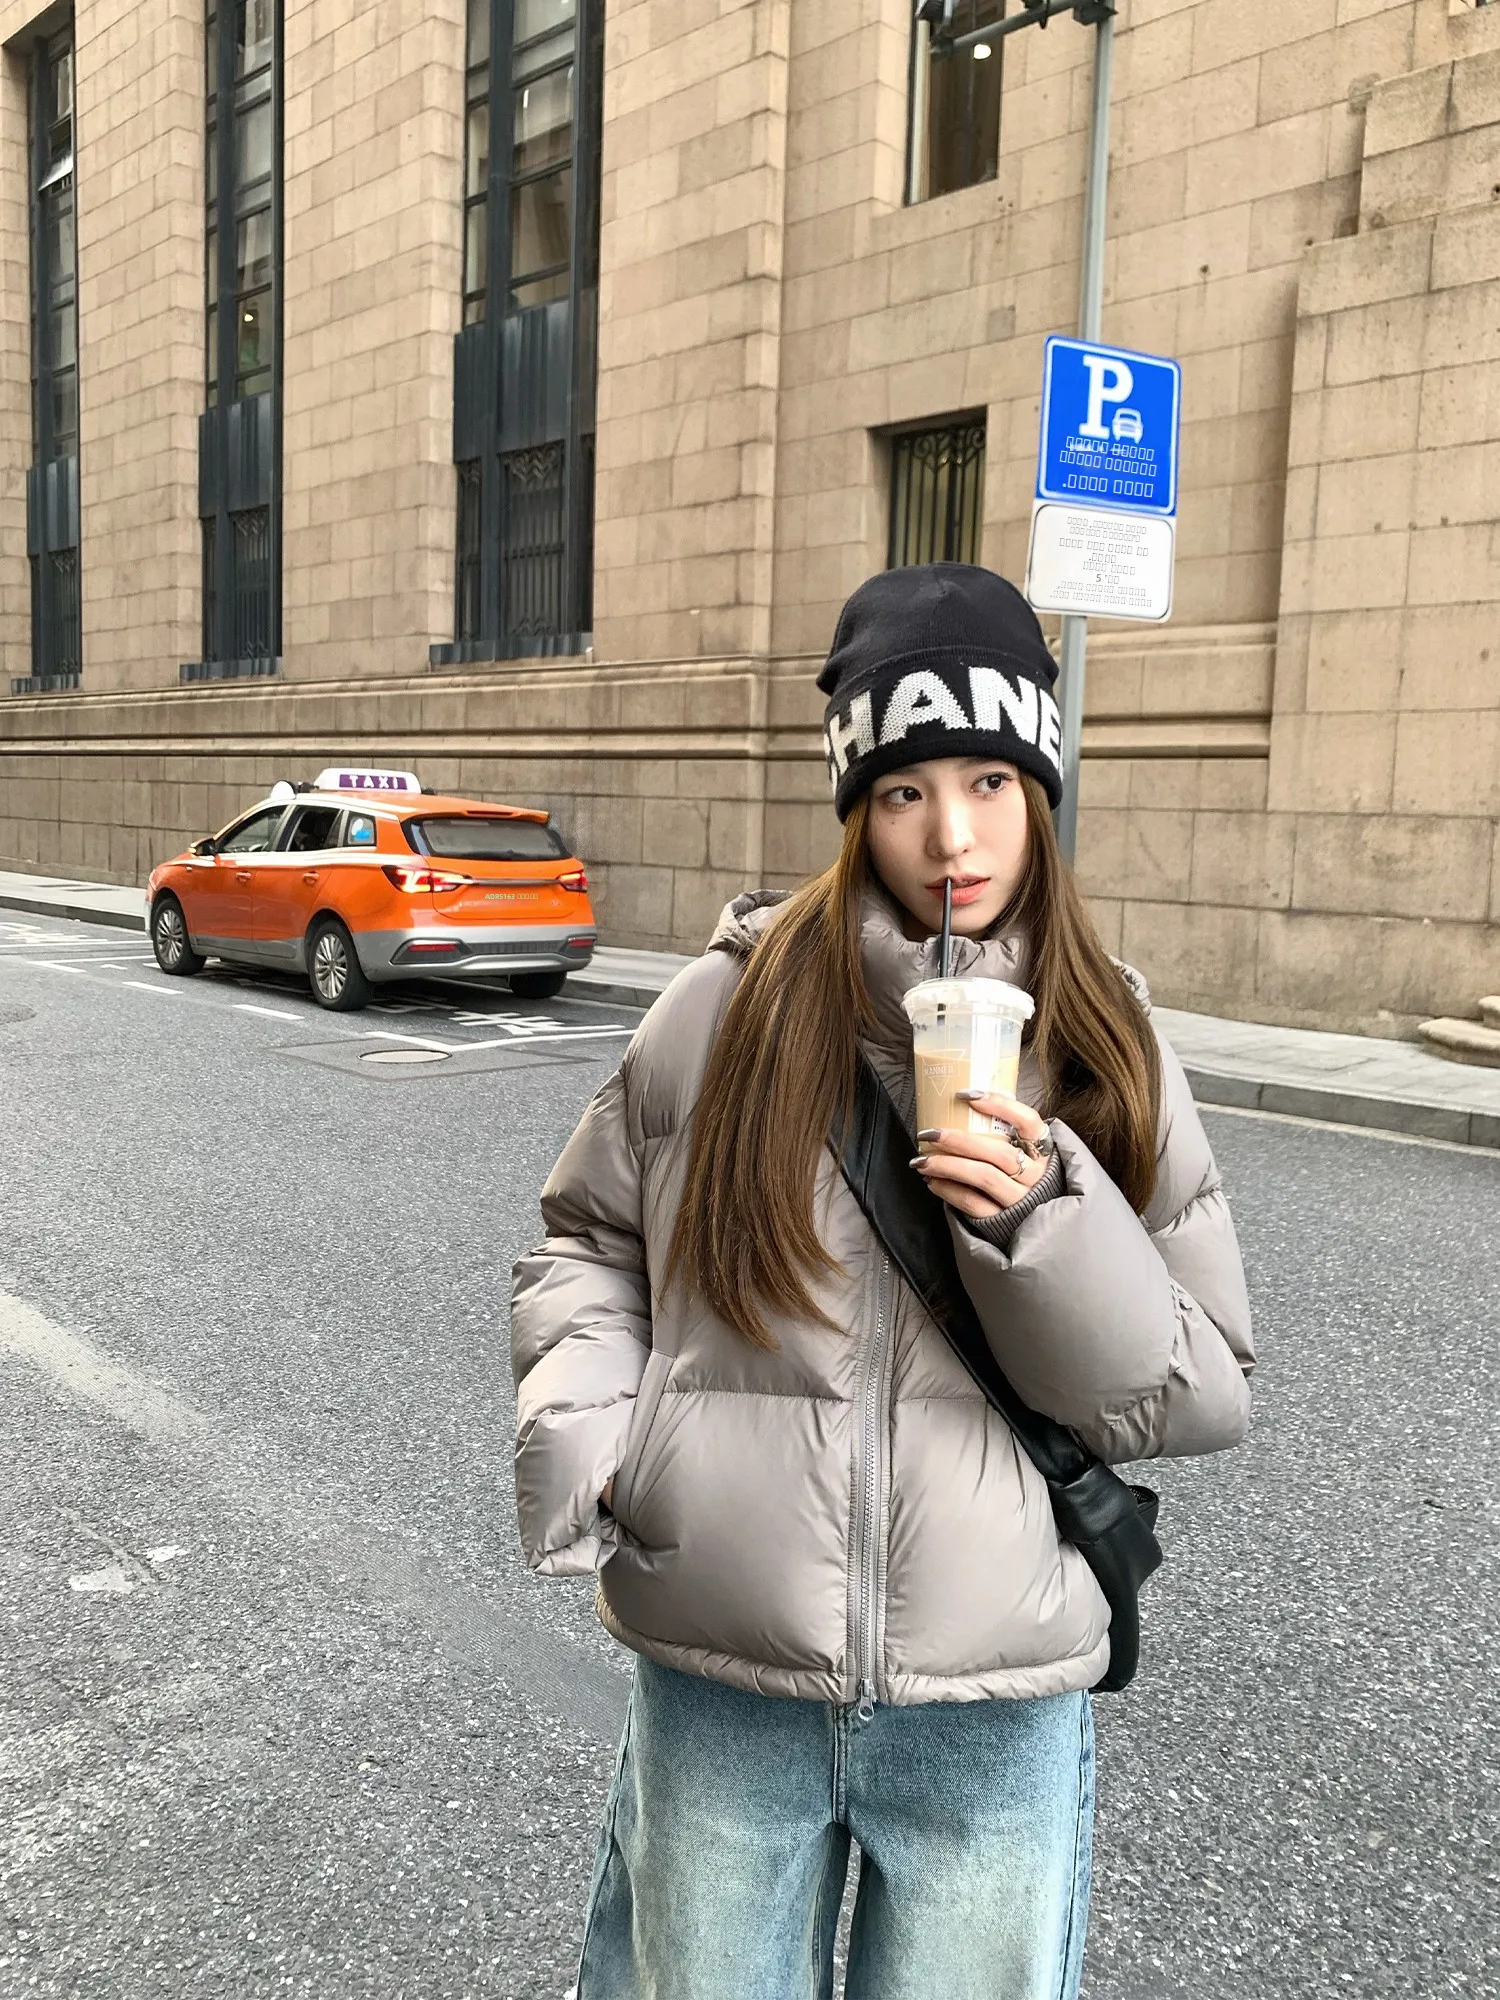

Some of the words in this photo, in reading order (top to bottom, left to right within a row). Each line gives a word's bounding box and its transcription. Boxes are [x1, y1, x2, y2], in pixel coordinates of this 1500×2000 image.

[1079, 354, 1134, 440] P
[823, 666, 1064, 796] HANE
[349, 776, 398, 788] TAXI
